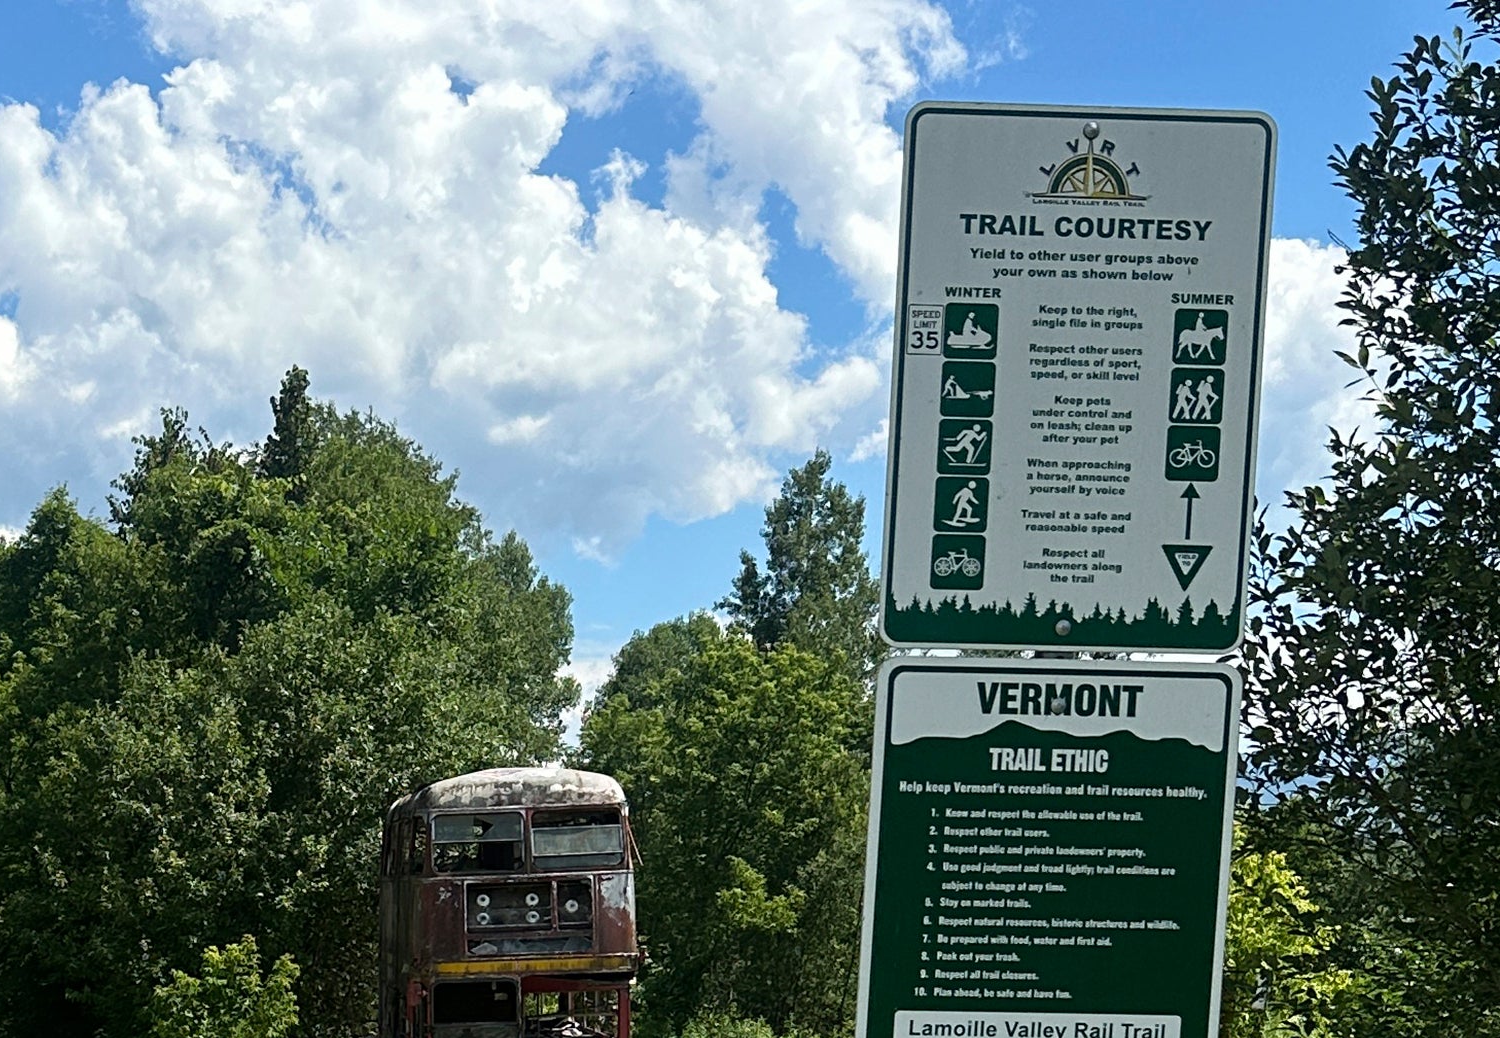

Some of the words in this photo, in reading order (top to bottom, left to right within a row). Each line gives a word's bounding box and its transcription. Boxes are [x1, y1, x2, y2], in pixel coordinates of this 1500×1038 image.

[959, 213, 1044, 236] TRAIL
[1054, 216, 1212, 241] COURTESY
[969, 247, 1005, 259] Yield
[1009, 249, 1024, 260] to
[1028, 249, 1066, 261] other
[1069, 253, 1101, 262] user
[1104, 254, 1153, 266] groups
[1156, 253, 1199, 266] above
[992, 268, 1024, 279] your
[1027, 269, 1057, 277] own
[1060, 269, 1077, 278] as
[1081, 268, 1127, 280] shown
[1131, 269, 1174, 281] below
[944, 286, 1001, 298] WINTER
[1170, 293, 1234, 305] SUMMER
[912, 310, 941, 319] SPEED
[1038, 304, 1068, 316] Keep
[1071, 305, 1083, 315] to
[1085, 306, 1104, 316] the
[1107, 306, 1137, 318] right,
[913, 320, 937, 328] LIMIT
[1031, 317, 1066, 329] single
[1069, 318, 1087, 328] file
[1090, 318, 1101, 328] in
[1104, 321, 1143, 331] groups
[911, 331, 938, 349] 35
[1029, 343, 1075, 355] Respect
[1078, 345, 1109, 355] other
[1111, 347, 1143, 356] users
[1029, 357, 1090, 368] regardless
[1093, 357, 1105, 367] of
[1107, 359, 1141, 370] sport,
[1030, 369, 1068, 381] speed,
[1085, 371, 1110, 380] skill
[1112, 371, 1139, 381] level
[1054, 395, 1083, 407] Keep
[1086, 397, 1111, 407] pets
[1032, 408, 1065, 417] under
[1067, 409, 1108, 418] control
[1110, 410, 1132, 419] and
[1047, 420, 1081, 431] leash;
[1084, 421, 1115, 431] clean
[1118, 424, 1132, 434] up
[1042, 433, 1070, 443] after
[1072, 436, 1098, 445] your
[1100, 435, 1119, 446] pet
[1026, 458, 1058, 468] When
[1061, 460, 1131, 472] approaching
[1026, 472, 1033, 480] a
[1036, 471, 1071, 482] horse,
[1074, 474, 1130, 483] announce
[1029, 484, 1075, 495] yourself
[1078, 485, 1092, 496] by
[1095, 486, 1125, 495] voice
[1020, 509, 1056, 519] Travel
[1058, 511, 1070, 519] at
[1073, 512, 1080, 520] a
[1083, 511, 1107, 520] safe
[1110, 512, 1131, 521] and
[1025, 523, 1088, 533] reasonable
[1091, 524, 1125, 535] speed
[1041, 547, 1088, 559] Respect
[1090, 549, 1105, 558] all
[1023, 560, 1088, 571] landowners
[1091, 561, 1122, 574] along
[1049, 573, 1068, 583] the
[1071, 574, 1094, 583] trail
[976, 681, 1144, 718] VERMONT
[989, 747, 1046, 771] TRAIL
[1050, 748, 1109, 773] ETHIC
[899, 780, 923, 794] Help
[925, 780, 951, 795] keep
[953, 781, 1005, 794] Vermont's
[1007, 783, 1062, 795] recreation
[1064, 783, 1084, 795] and
[1086, 784, 1109, 796] trail
[1111, 787, 1163, 797] resources
[1165, 785, 1207, 800] healthy.
[908, 1019, 997, 1037] Lamoille
[1074, 1022, 1113, 1038] Rail
